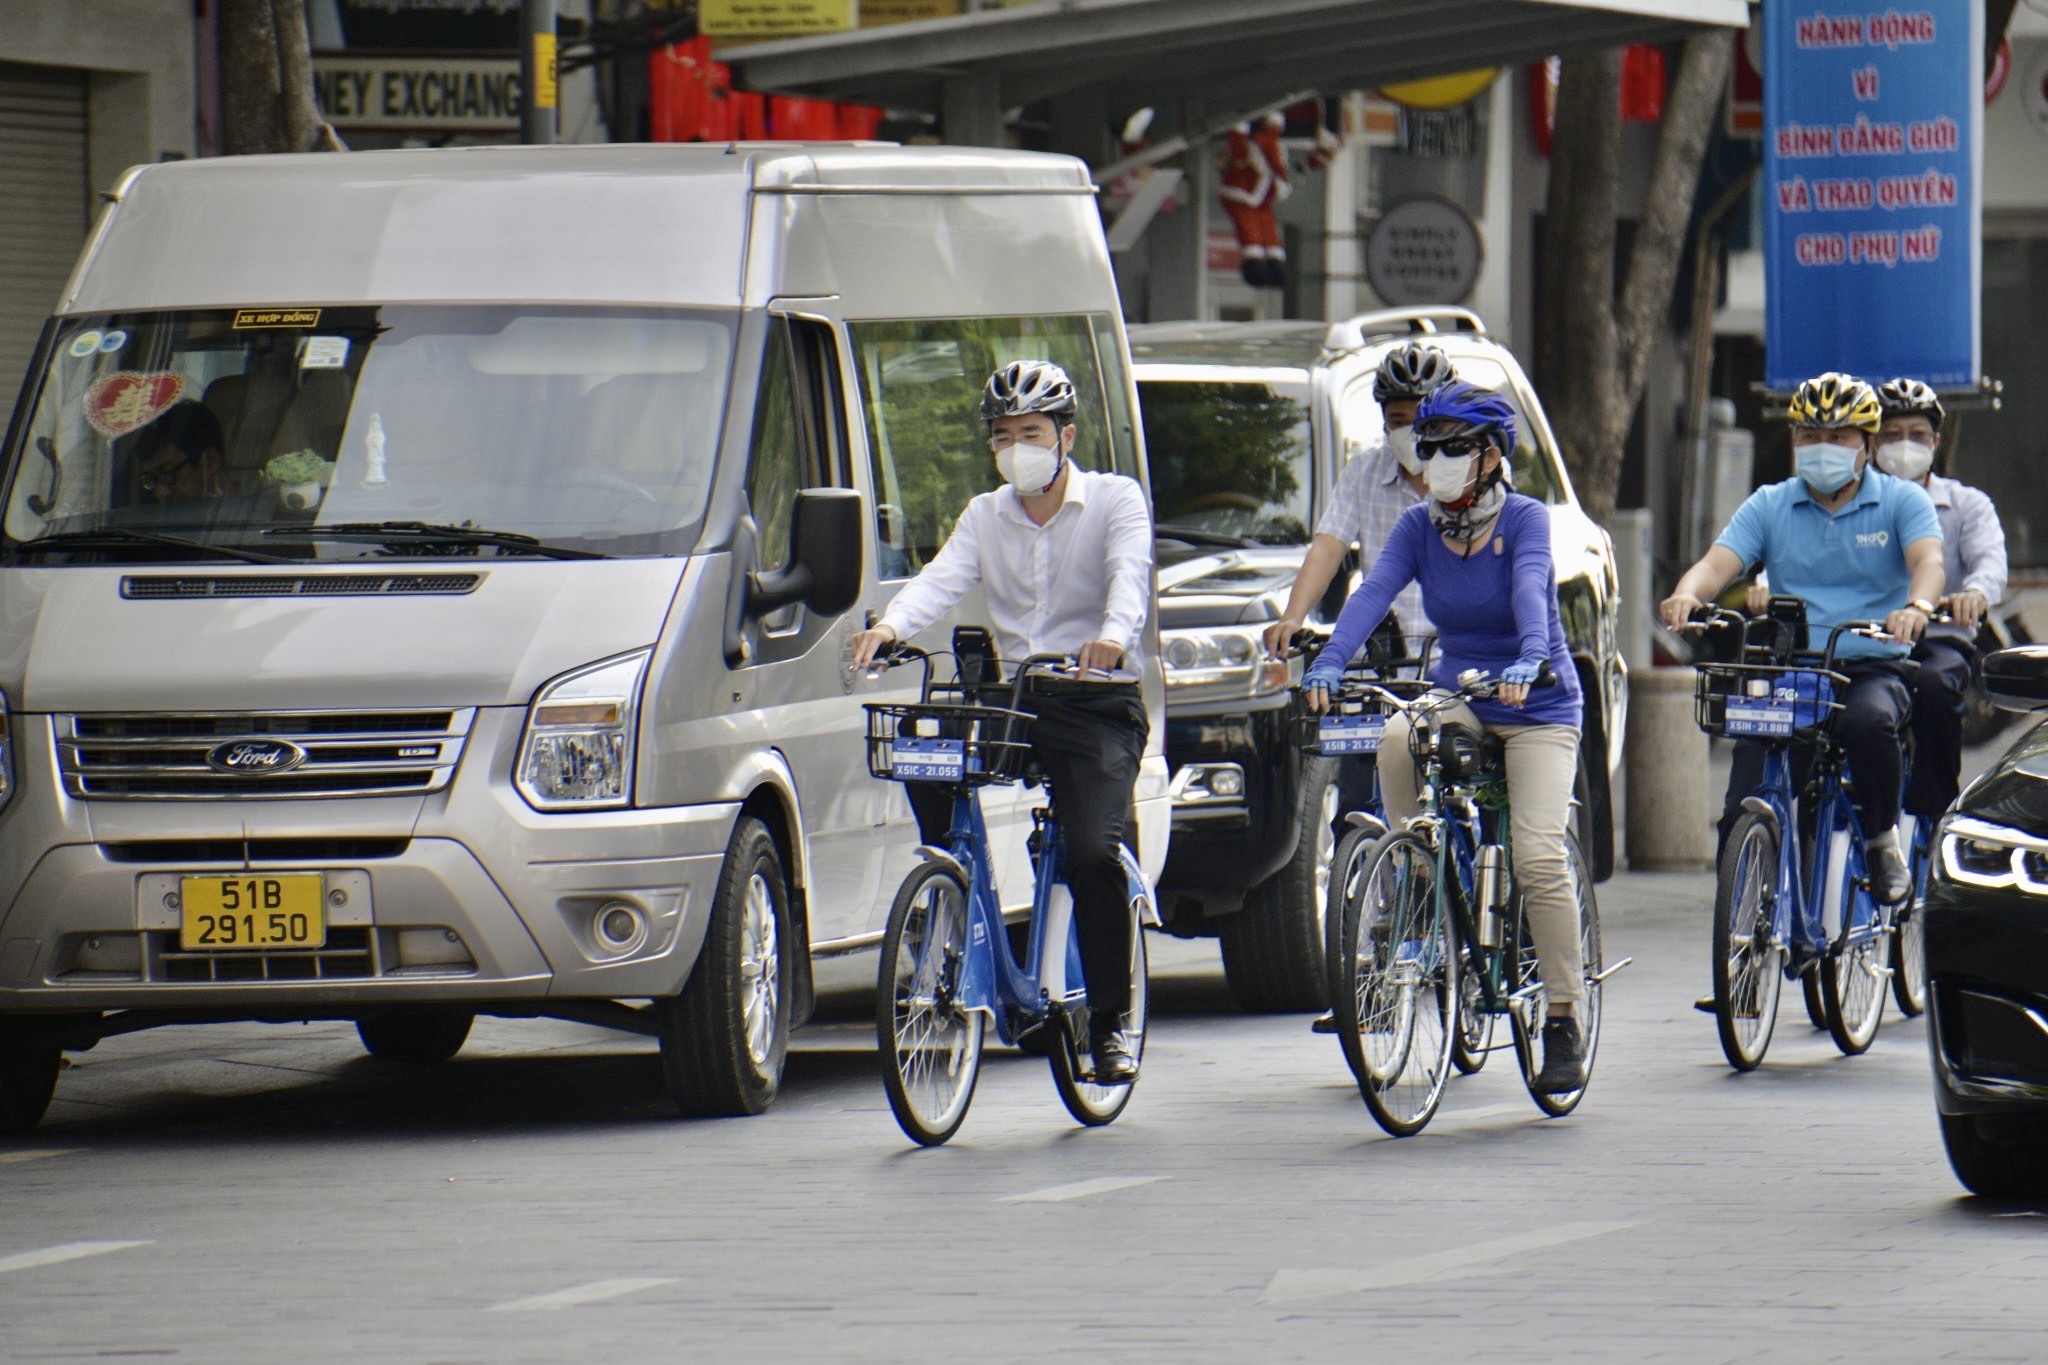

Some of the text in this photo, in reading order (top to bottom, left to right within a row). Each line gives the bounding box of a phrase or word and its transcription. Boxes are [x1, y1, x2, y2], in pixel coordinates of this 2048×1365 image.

[1796, 7, 1935, 51] HÀNH ĐỘNG
[1852, 63, 1878, 101] VÌ
[1776, 121, 1834, 157] BÌNH
[1907, 115, 1959, 153] GIỚI
[1778, 175, 1811, 212] VÀ
[1813, 178, 1874, 211] TRAO
[1795, 224, 1942, 269] CHO PHỤ NỮ
[240, 311, 315, 324] XE HỢP ĐỒNG
[225, 743, 281, 766] Ford
[221, 880, 281, 909] 51B
[197, 913, 308, 944] 291.50
